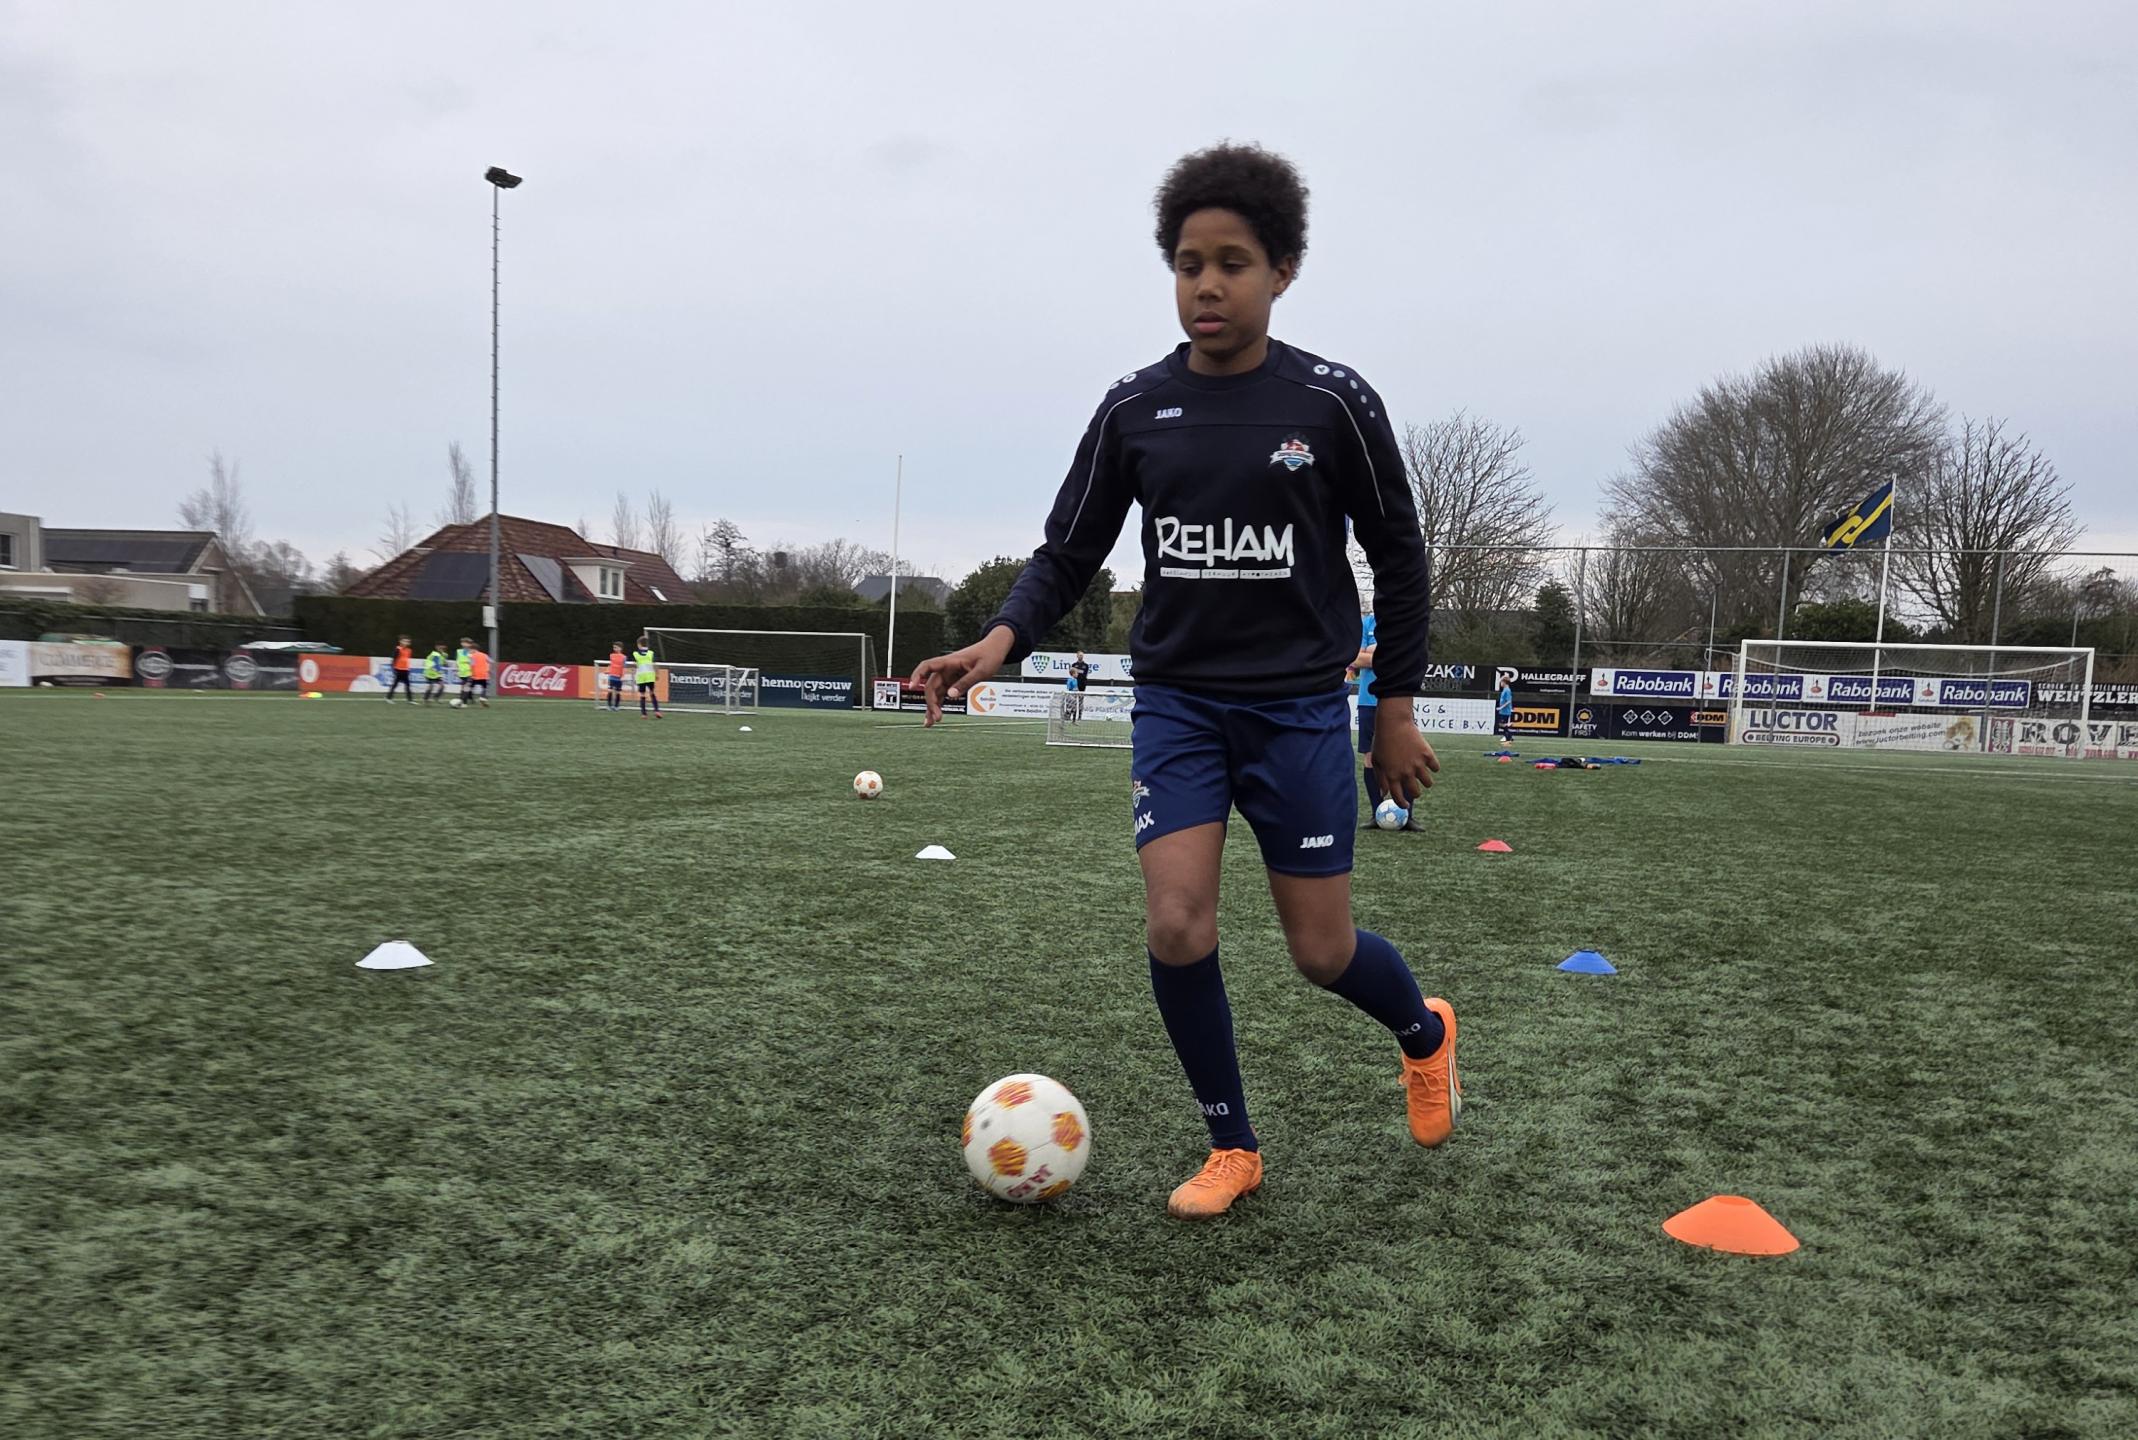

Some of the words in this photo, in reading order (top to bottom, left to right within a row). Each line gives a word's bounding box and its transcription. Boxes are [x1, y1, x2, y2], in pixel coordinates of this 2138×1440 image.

[1154, 407, 1182, 419] JAKO
[1155, 516, 1294, 567] REHAM
[1052, 659, 1100, 674] Linge
[670, 672, 709, 685] henno
[711, 677, 757, 688] cyuw
[761, 676, 802, 689] henno
[1520, 673, 1587, 682] HALLEGRAEFF
[1616, 675, 1693, 692] Rabobank
[1722, 678, 1801, 695] Rbobank
[1437, 704, 1447, 714] &
[1511, 711, 1556, 724] DDM
[1749, 710, 1838, 730] LUCTOR
[1463, 720, 1490, 730] B.V.
[1638, 730, 1666, 738] werken
[1793, 735, 1827, 743] EUROPE
[1300, 835, 1334, 848] JAKO
